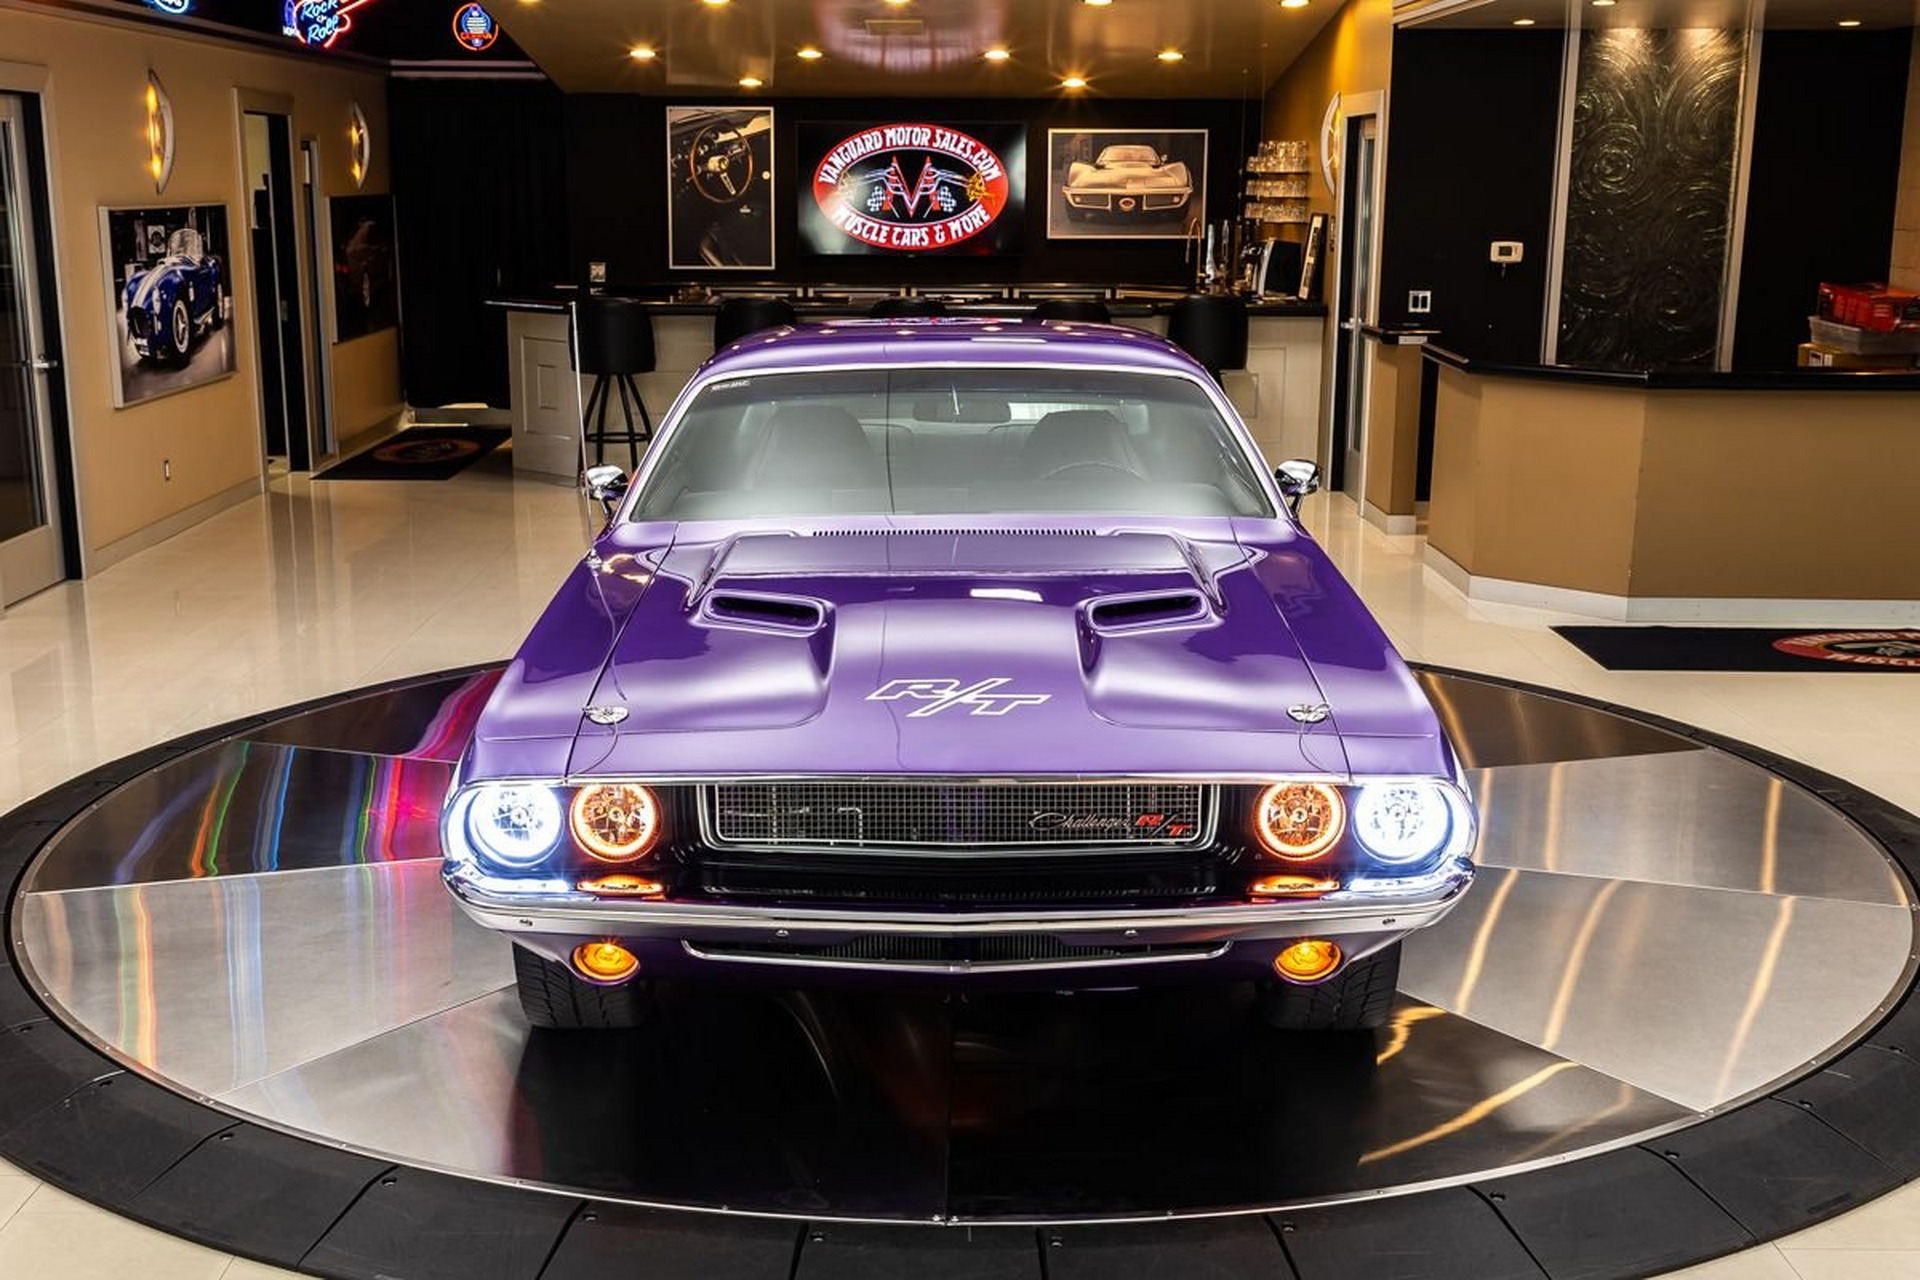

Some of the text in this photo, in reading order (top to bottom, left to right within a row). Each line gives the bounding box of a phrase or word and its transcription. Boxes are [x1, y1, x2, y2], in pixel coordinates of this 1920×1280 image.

[818, 127, 1002, 185] VANGUARD MOTOR SALES.COM
[833, 204, 991, 246] MUSCLE CARS & MORE
[864, 677, 1052, 717] R/T
[1029, 812, 1193, 836] Challenger R/T
